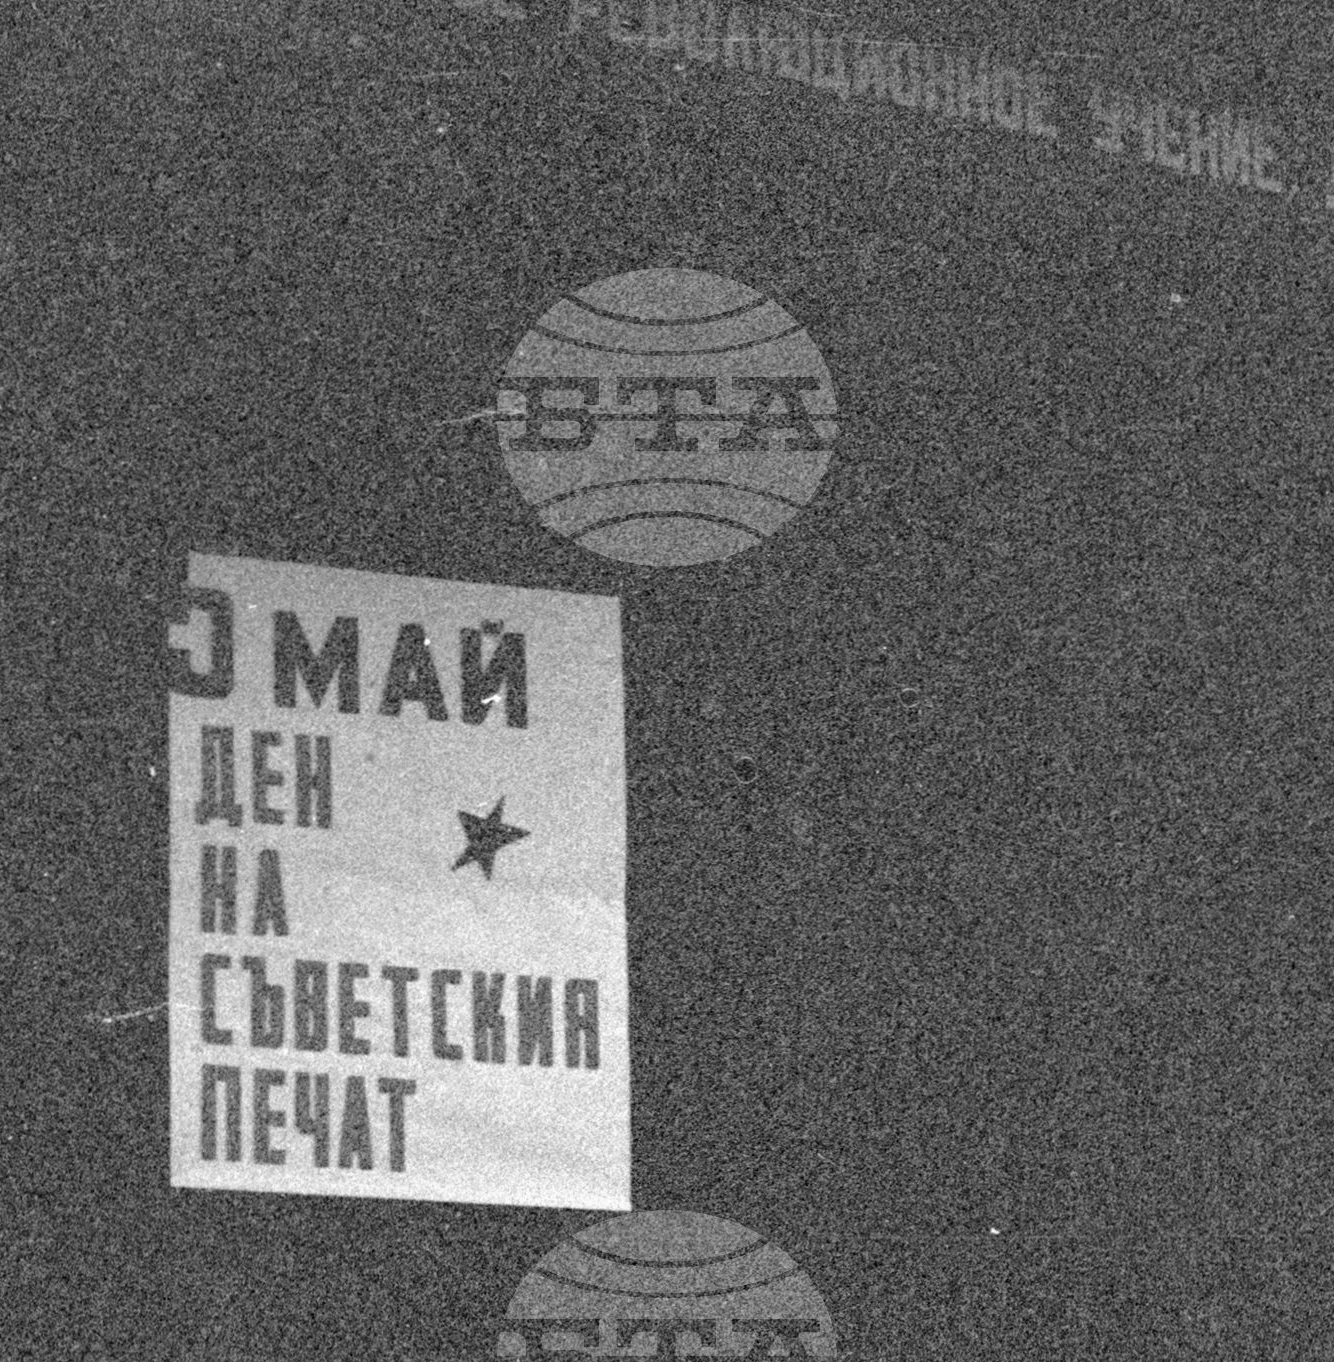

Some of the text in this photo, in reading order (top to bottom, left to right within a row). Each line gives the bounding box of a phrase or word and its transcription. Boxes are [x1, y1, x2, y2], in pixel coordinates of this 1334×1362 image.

[273, 609, 529, 729] МАЙ
[194, 724, 333, 830] ДЕН
[201, 844, 290, 937] НА
[200, 952, 601, 1071] СЪВЕТСКИЯ
[199, 1062, 418, 1173] ПЕЧАТ
